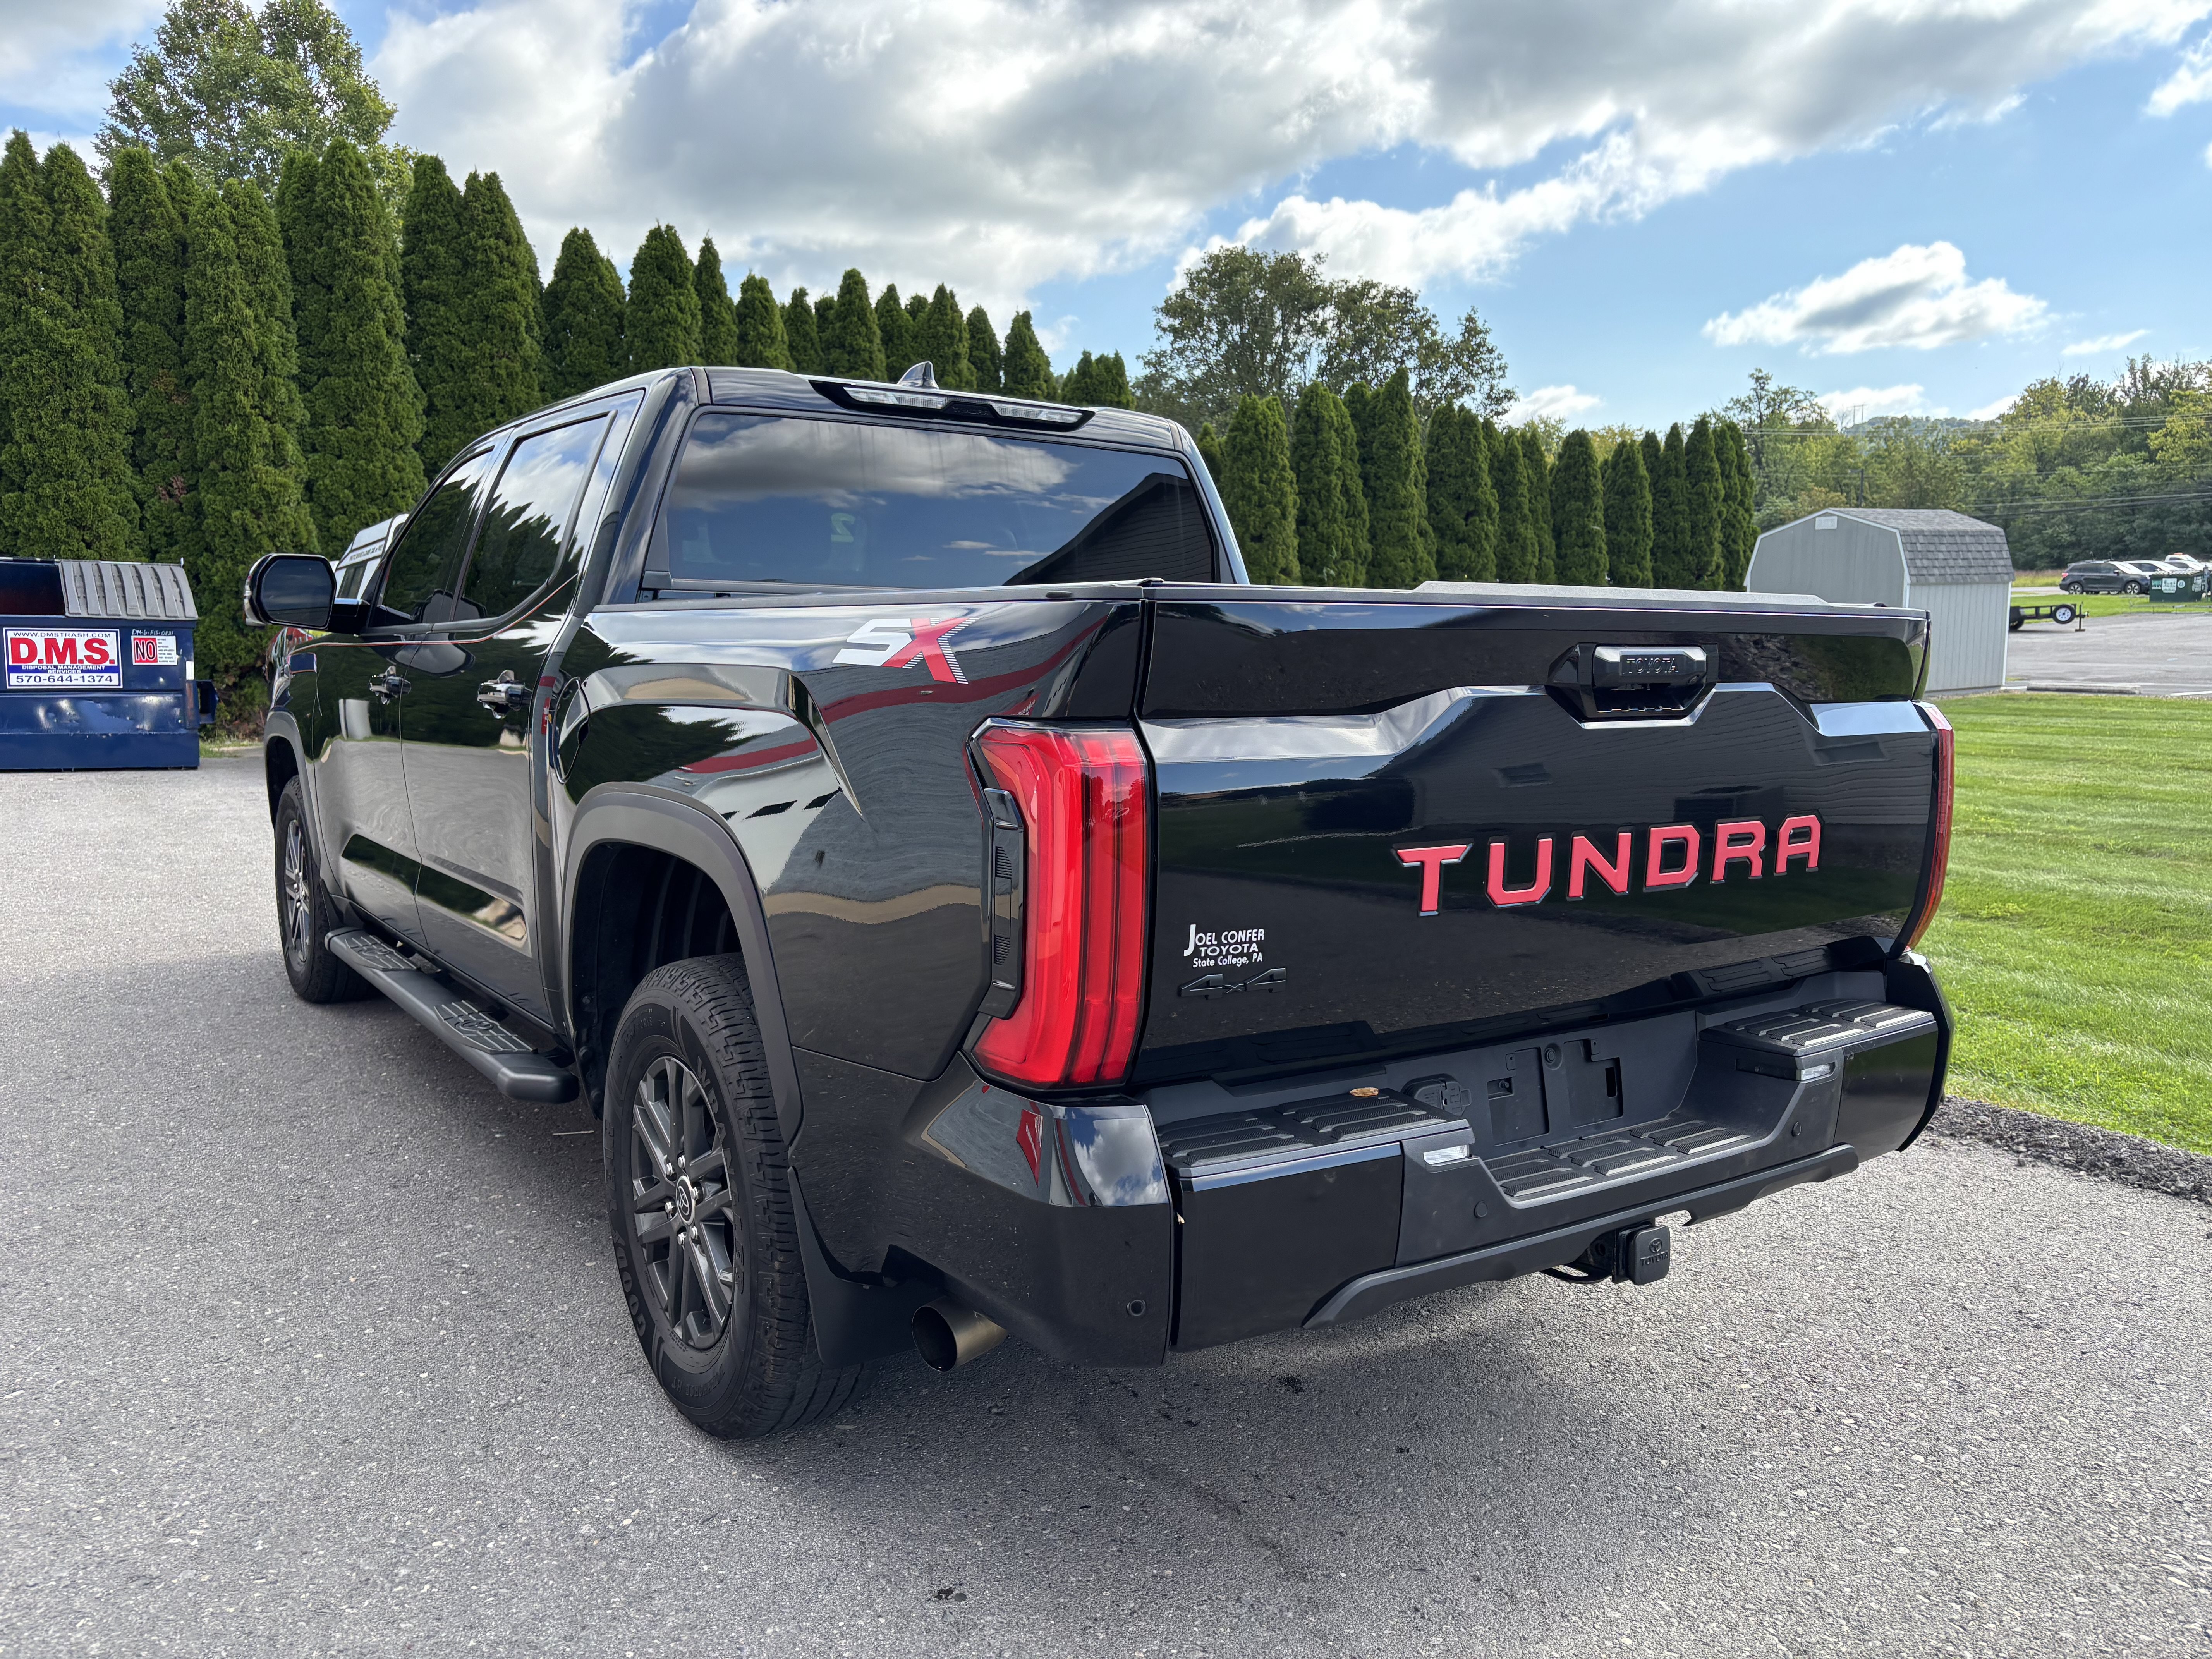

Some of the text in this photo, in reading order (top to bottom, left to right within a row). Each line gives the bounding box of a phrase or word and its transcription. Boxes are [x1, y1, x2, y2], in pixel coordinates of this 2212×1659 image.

[10, 637, 115, 665] D.M.S.
[134, 640, 156, 661] NO
[832, 617, 980, 684] SX
[1626, 658, 1678, 673] TOYOTA
[1393, 811, 1824, 916] TUNDRA
[1183, 924, 1264, 957] JOEL CONFER
[1199, 943, 1259, 957] TOYOTA
[1193, 952, 1262, 968] State College, PA
[1640, 1250, 1669, 1267] TOYOTA
